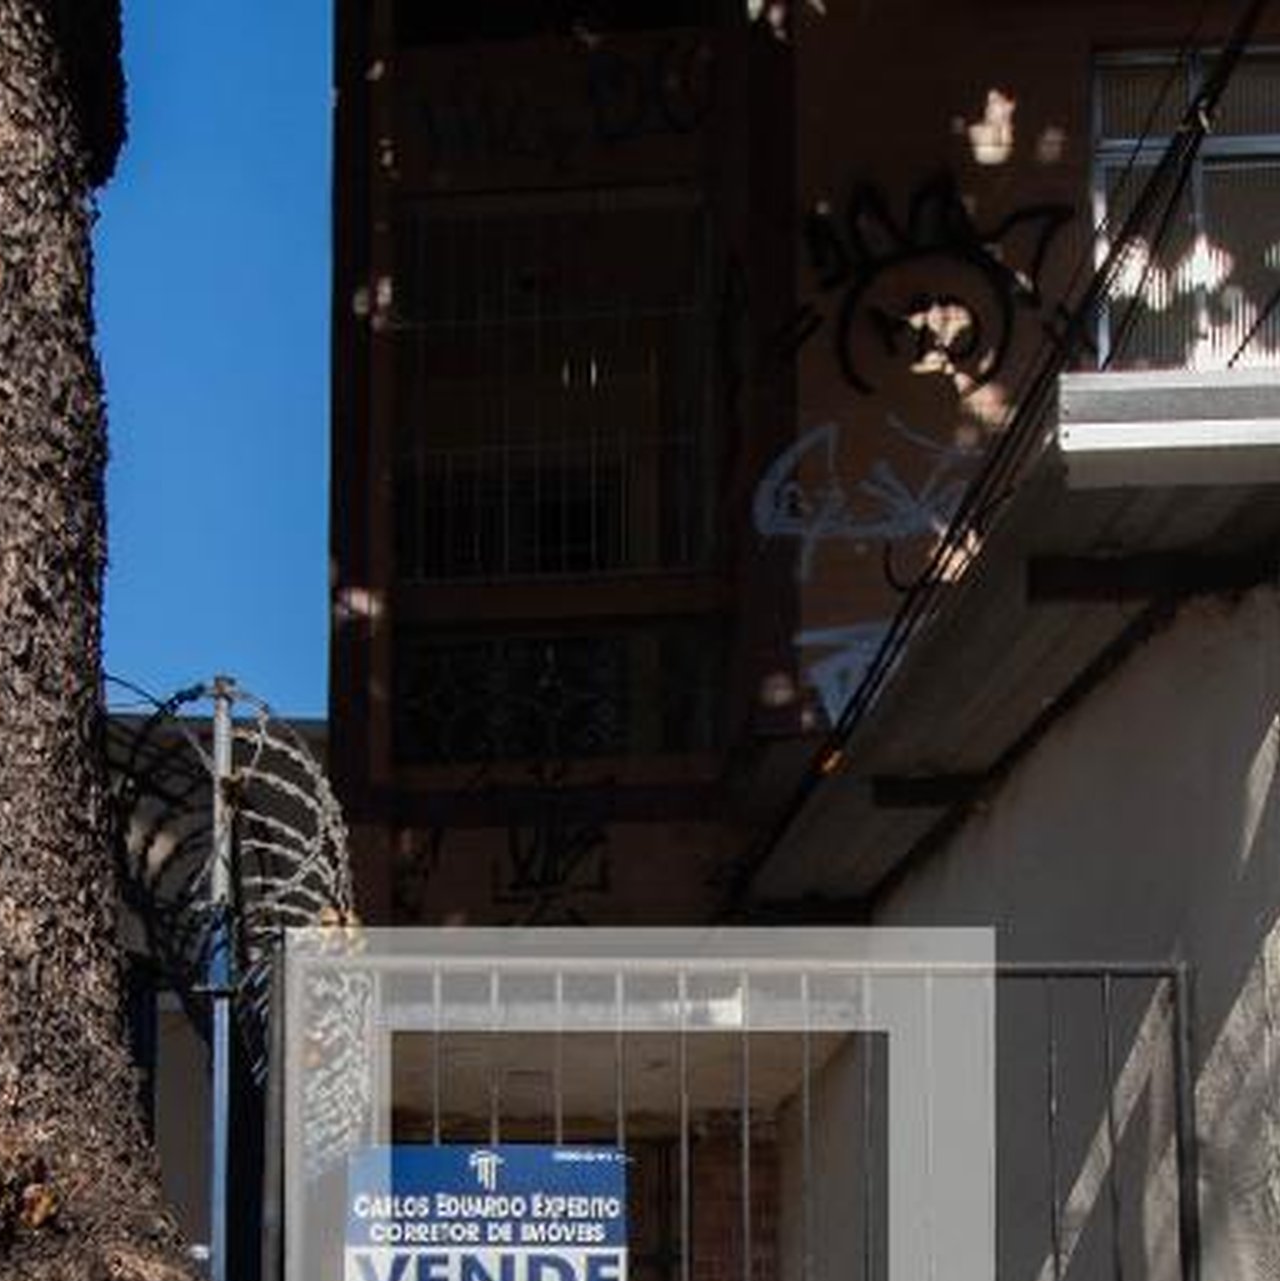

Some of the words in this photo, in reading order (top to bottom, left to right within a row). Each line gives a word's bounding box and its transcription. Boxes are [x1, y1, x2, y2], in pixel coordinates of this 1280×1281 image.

[354, 1196, 428, 1219] CARLOS
[436, 1194, 526, 1219] EDUARDO
[532, 1193, 619, 1219] EXPEDITO
[370, 1223, 479, 1243] CORRETOR
[487, 1224, 513, 1242] DE
[521, 1220, 605, 1242] IMÓVEIS
